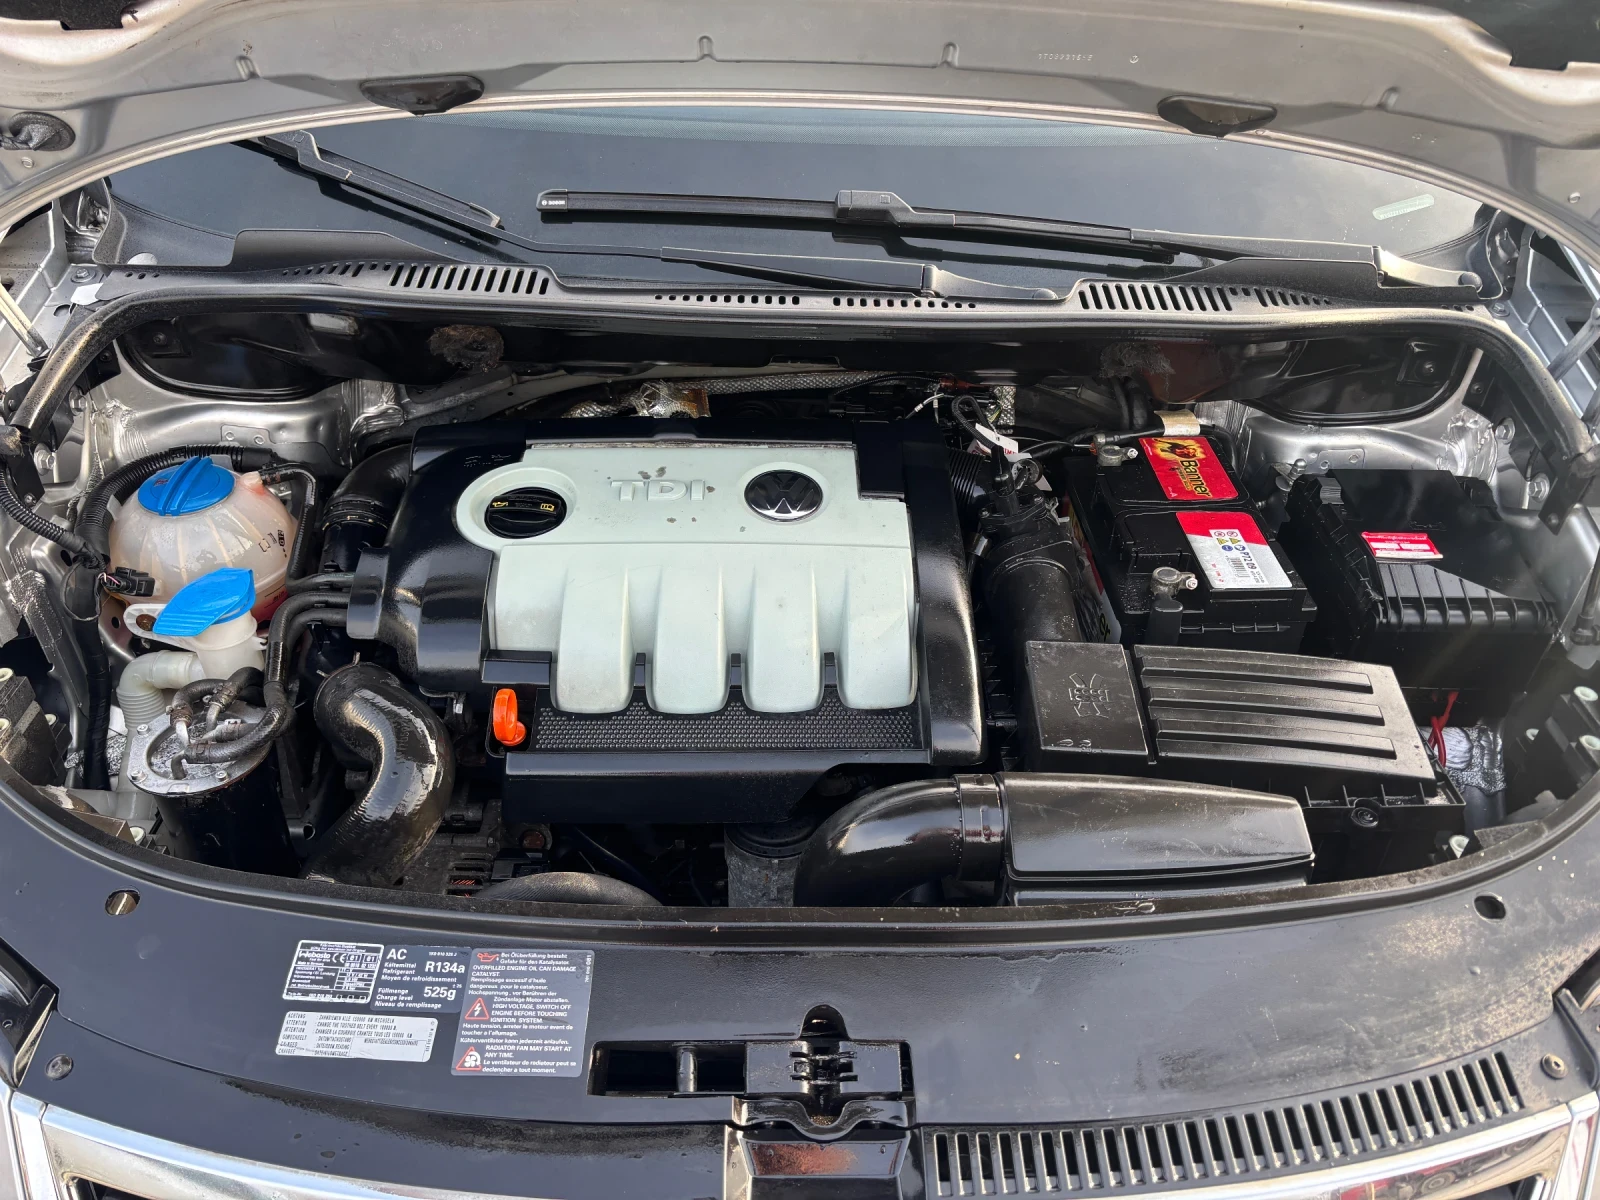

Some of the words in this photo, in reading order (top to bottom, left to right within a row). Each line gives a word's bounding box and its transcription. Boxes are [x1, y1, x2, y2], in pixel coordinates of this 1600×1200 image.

[1180, 460, 1212, 497] Banner
[610, 479, 706, 502] TDI
[386, 948, 407, 960] AC
[425, 961, 466, 974] R134a
[424, 986, 456, 1000] 525g
